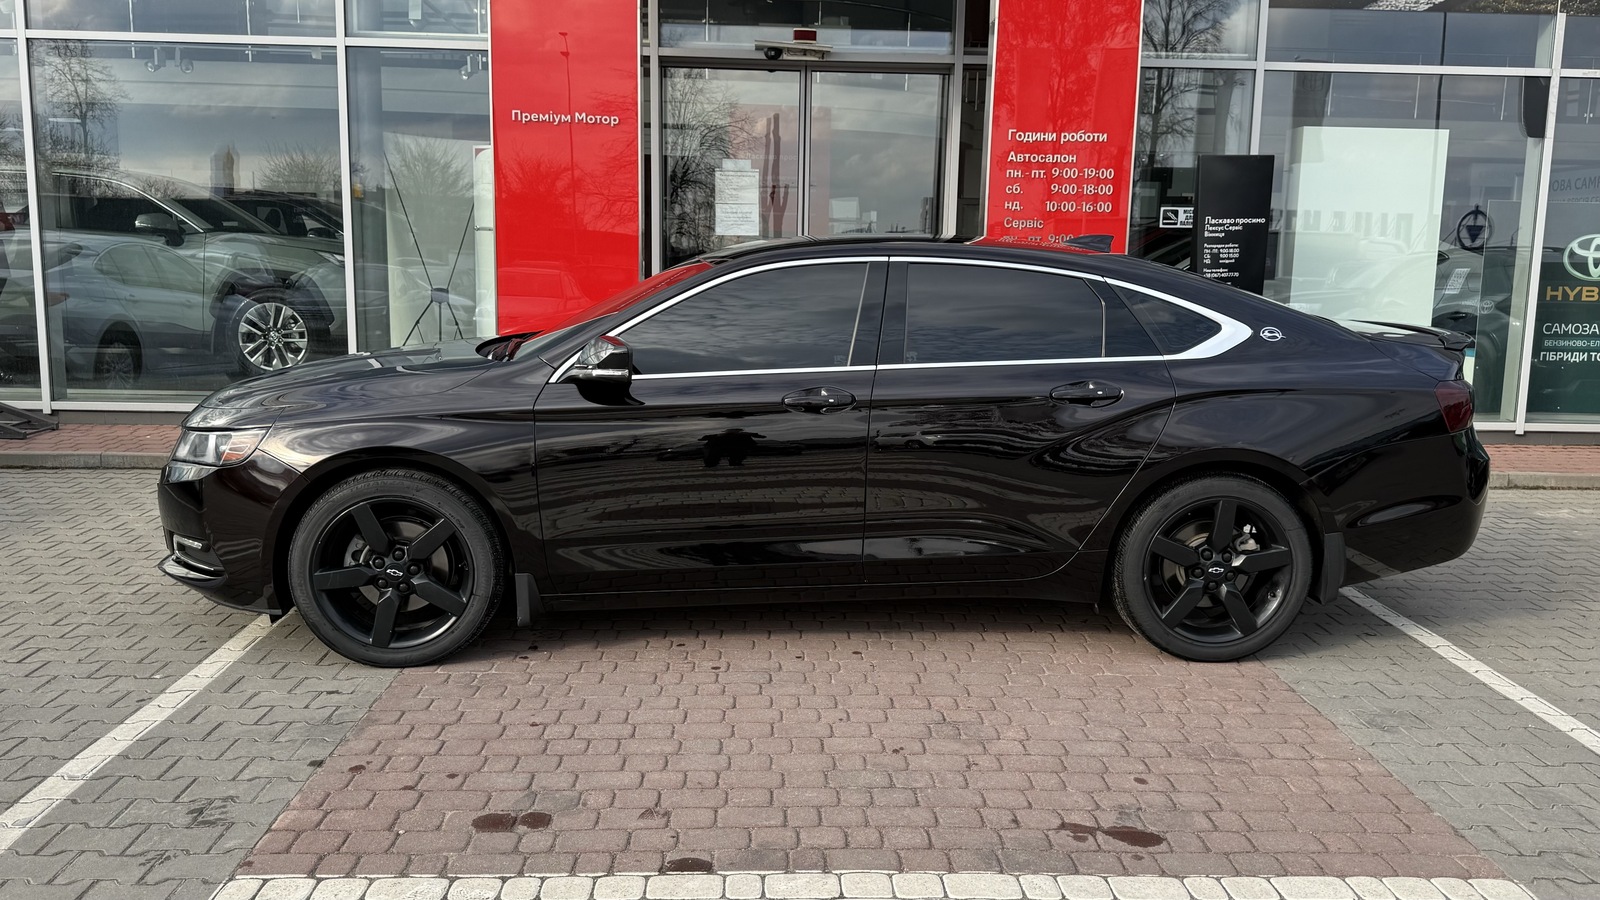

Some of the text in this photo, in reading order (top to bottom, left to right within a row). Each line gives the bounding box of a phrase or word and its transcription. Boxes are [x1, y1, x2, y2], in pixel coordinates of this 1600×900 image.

[511, 109, 619, 126] Преміум Мотор
[1008, 129, 1108, 144] Години роботи
[1007, 151, 1077, 163] Автосалон
[1051, 167, 1114, 179] 9:00-19:00
[1005, 183, 1113, 195] сб. 9:00-18:00
[1004, 201, 1112, 212] нд. 10:00-16:00
[1004, 217, 1044, 230] Сервіс
[1205, 216, 1234, 225] Ласкаво
[1543, 323, 1600, 335] САМОЗА
[1540, 352, 1588, 363] ГІБРИДИ
